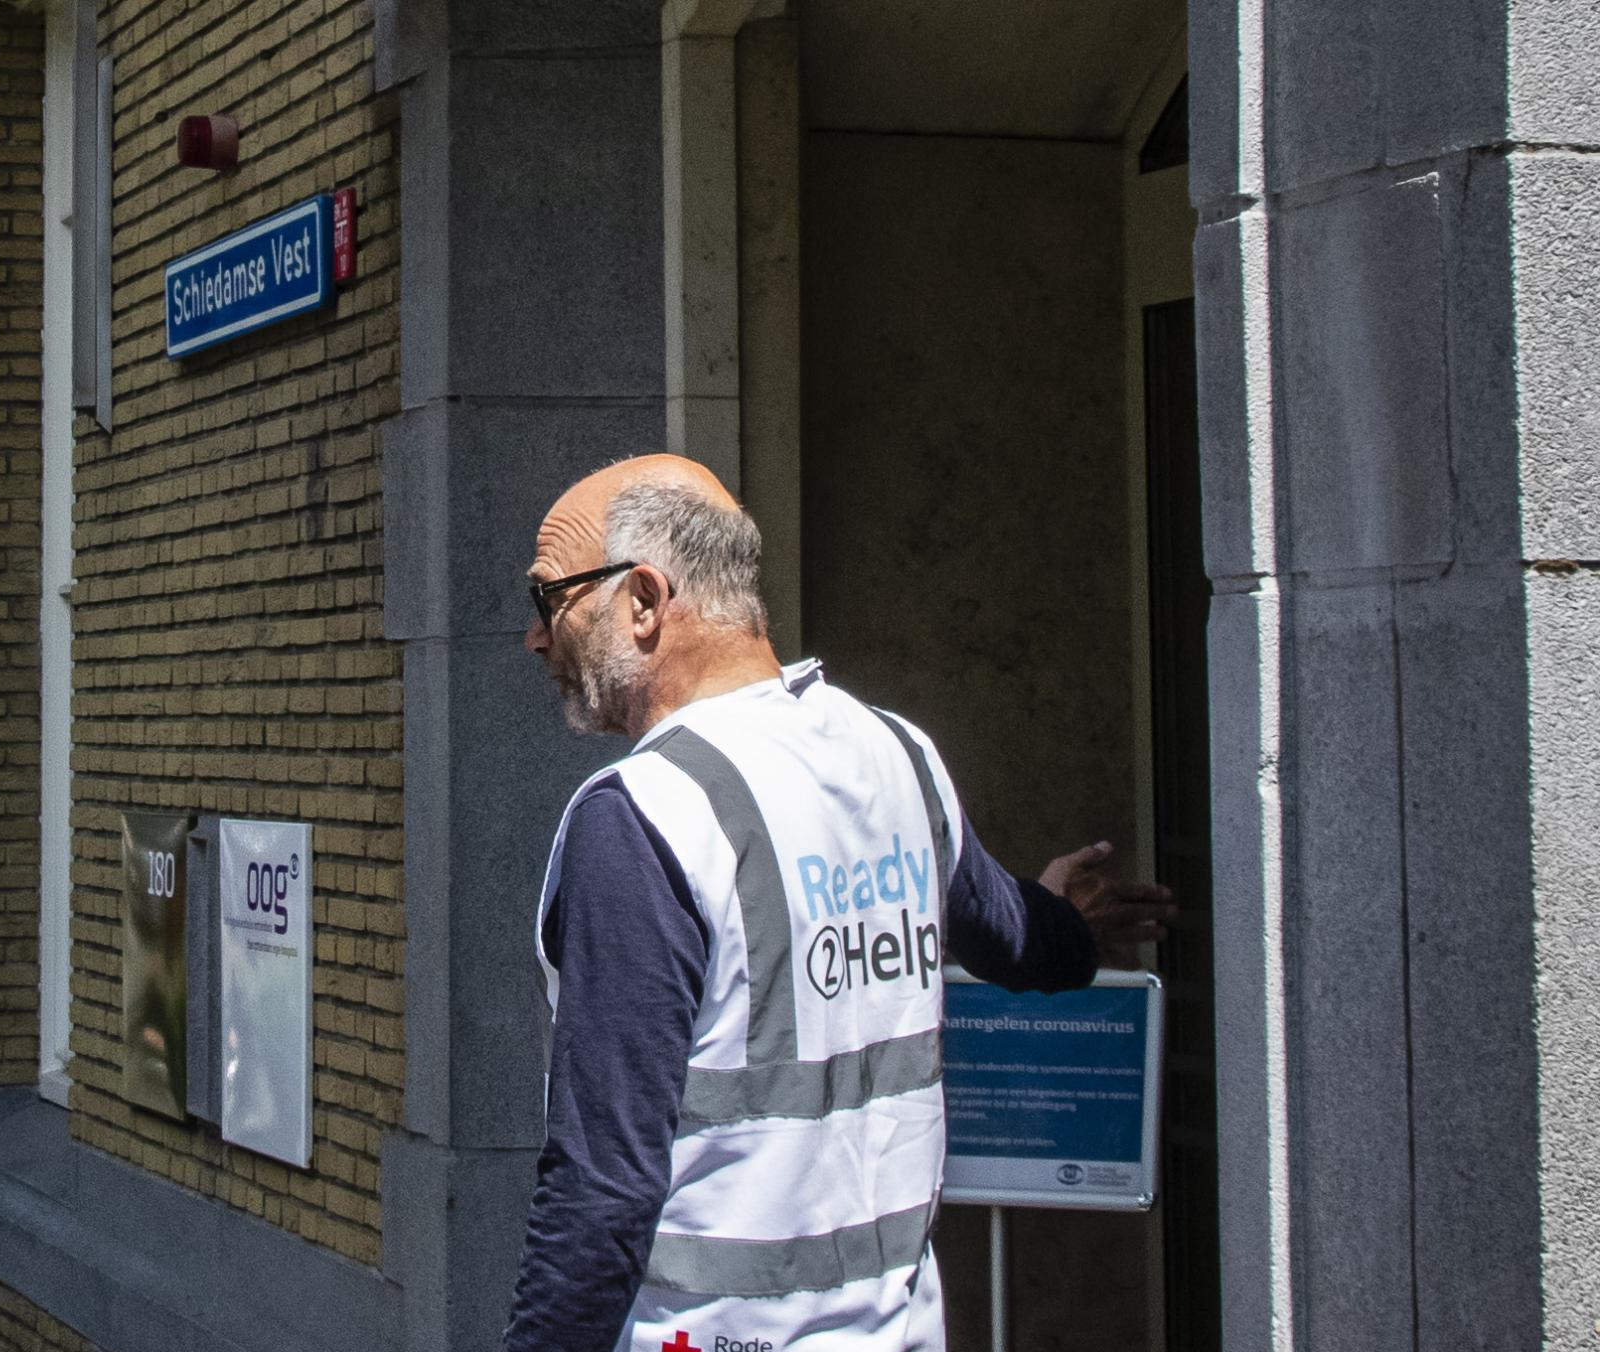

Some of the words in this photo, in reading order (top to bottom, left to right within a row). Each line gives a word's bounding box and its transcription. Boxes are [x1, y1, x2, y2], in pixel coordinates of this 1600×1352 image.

[173, 254, 266, 326] Schiedamse
[271, 225, 311, 286] Vest
[147, 851, 175, 898] 180
[247, 861, 289, 936] oog
[797, 832, 929, 922] Ready
[1033, 1018, 1136, 1034] coronavirus
